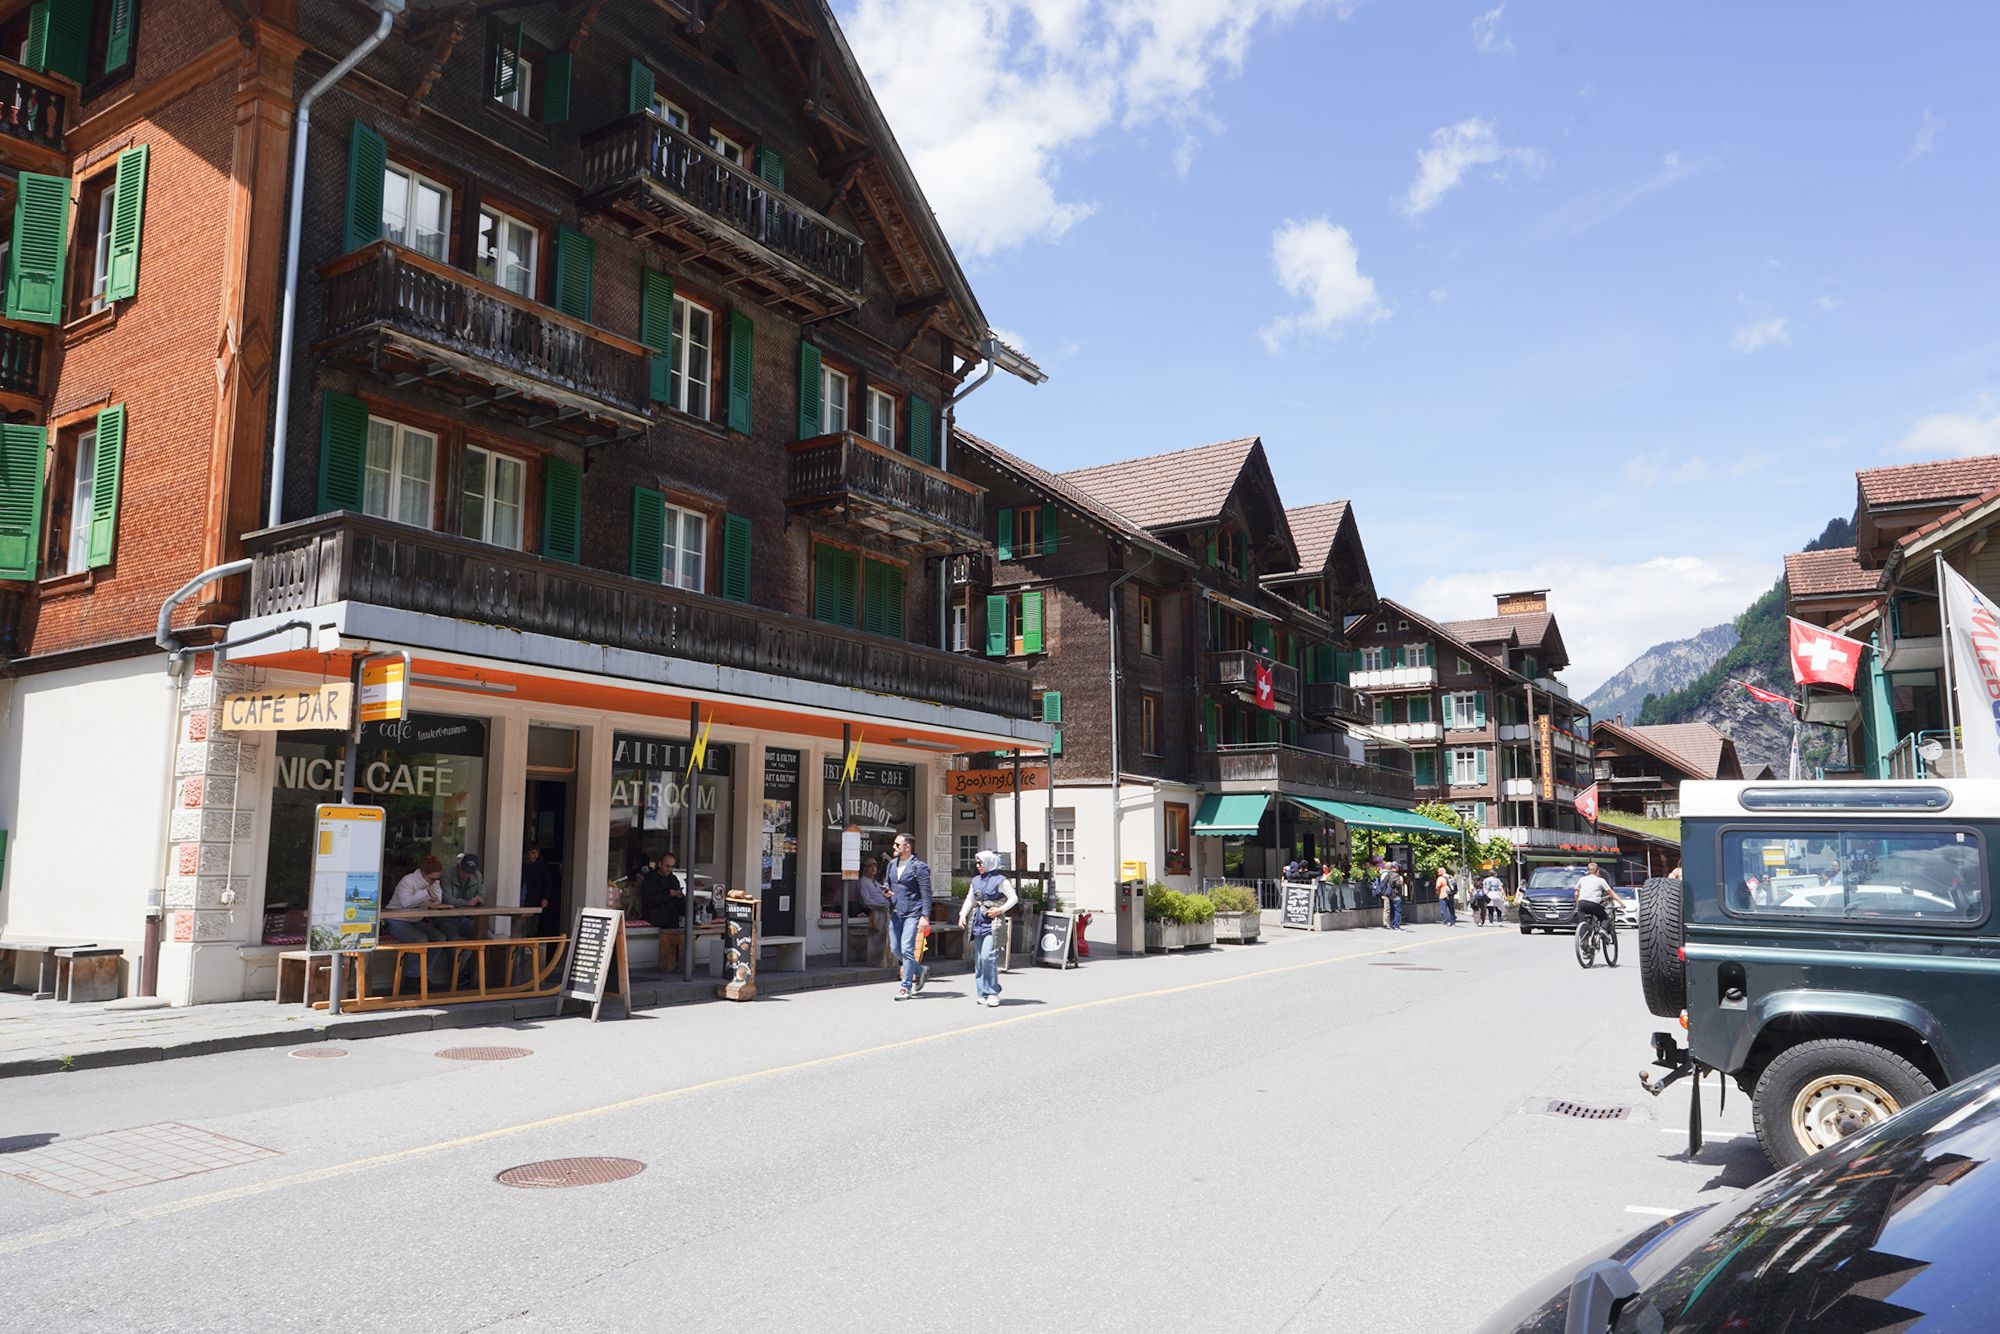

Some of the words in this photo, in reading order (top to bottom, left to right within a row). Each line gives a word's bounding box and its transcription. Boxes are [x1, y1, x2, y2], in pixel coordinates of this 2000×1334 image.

[1501, 603, 1543, 613] OBERLAND
[231, 694, 286, 725] CAFÉ
[296, 691, 338, 723] BAR
[1540, 716, 1550, 747] HOTEL
[614, 740, 719, 770] AIRTIE
[366, 758, 454, 797] CAFÉ
[955, 774, 1005, 791] Booking
[1006, 771, 1036, 787] Oice
[1542, 749, 1552, 797] OBERLAND
[827, 799, 893, 827] LATERBROT
